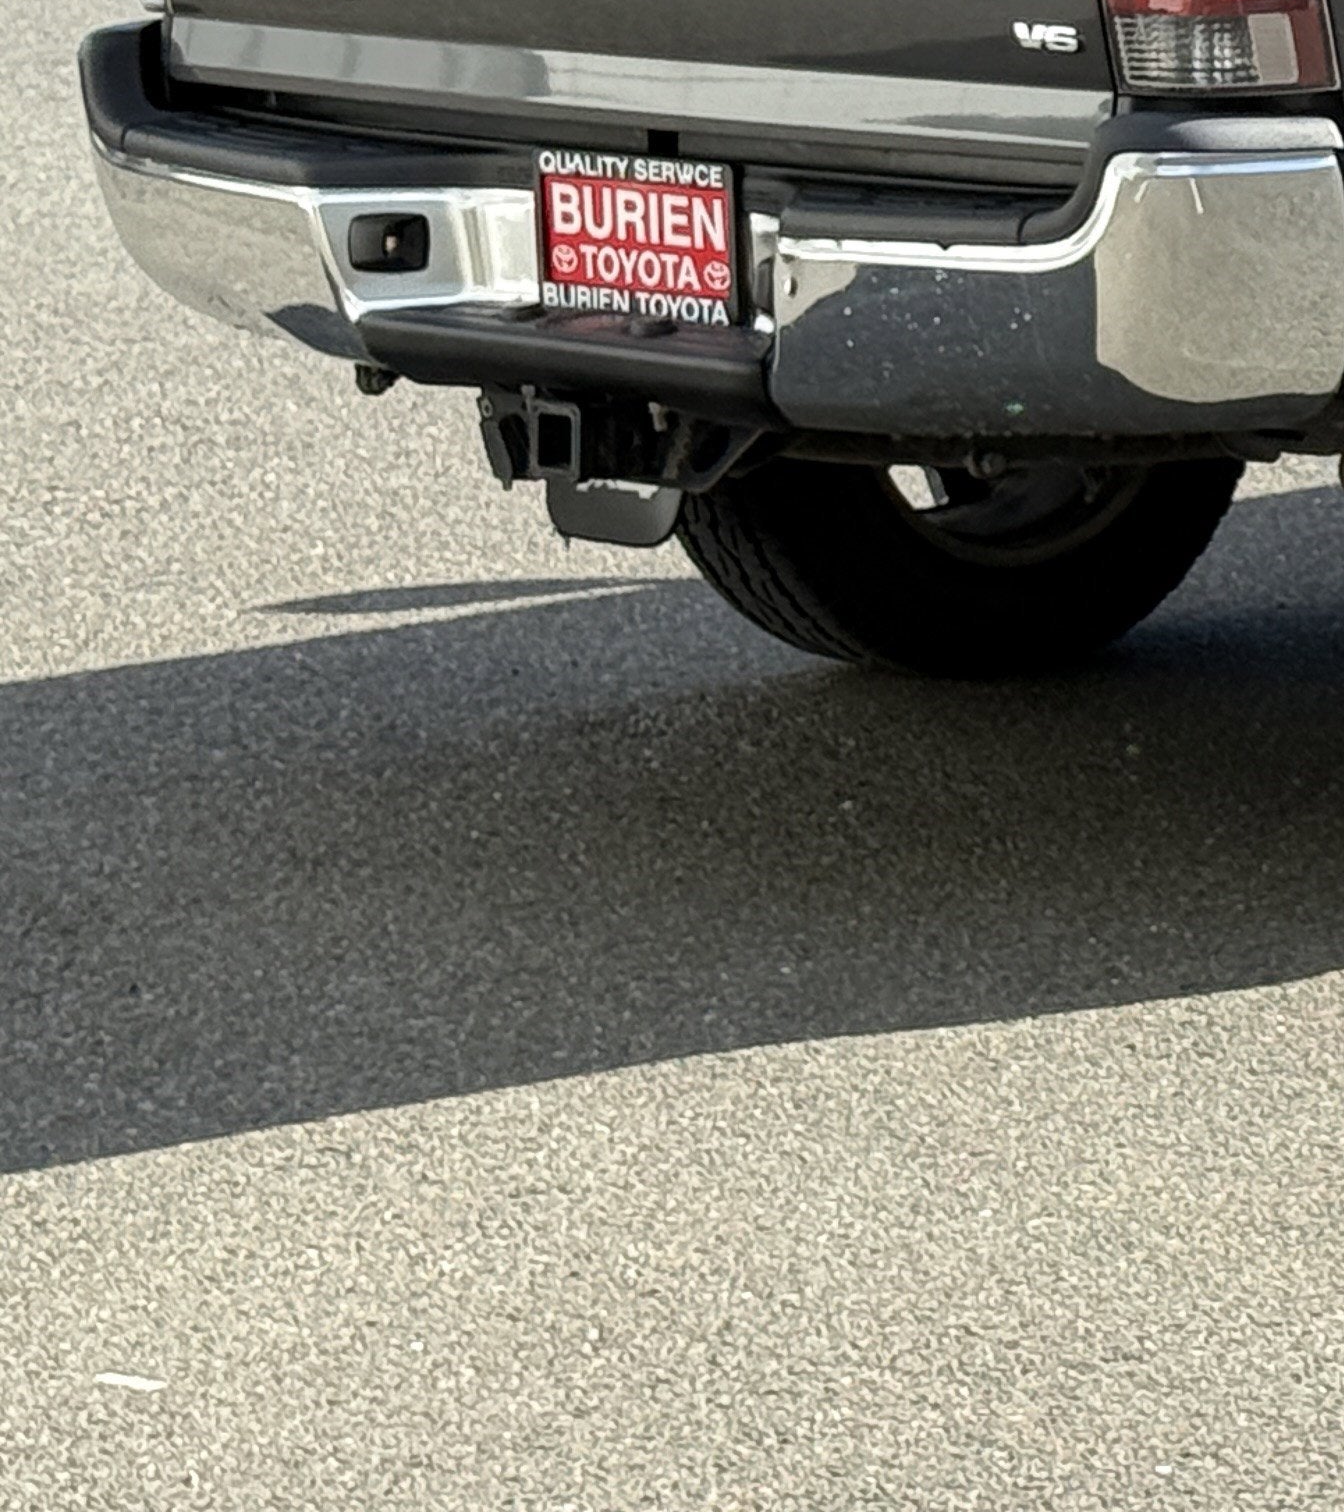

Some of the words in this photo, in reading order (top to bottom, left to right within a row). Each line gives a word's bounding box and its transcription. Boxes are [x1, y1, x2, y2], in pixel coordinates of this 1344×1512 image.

[1013, 22, 1078, 52] V6
[538, 150, 629, 179] QUALITY
[633, 158, 723, 187] SERVICE
[551, 182, 726, 251] BURIEN
[579, 243, 702, 291] TOYOTA
[543, 281, 630, 313] BURIEN
[635, 291, 730, 326] TOYOTA
